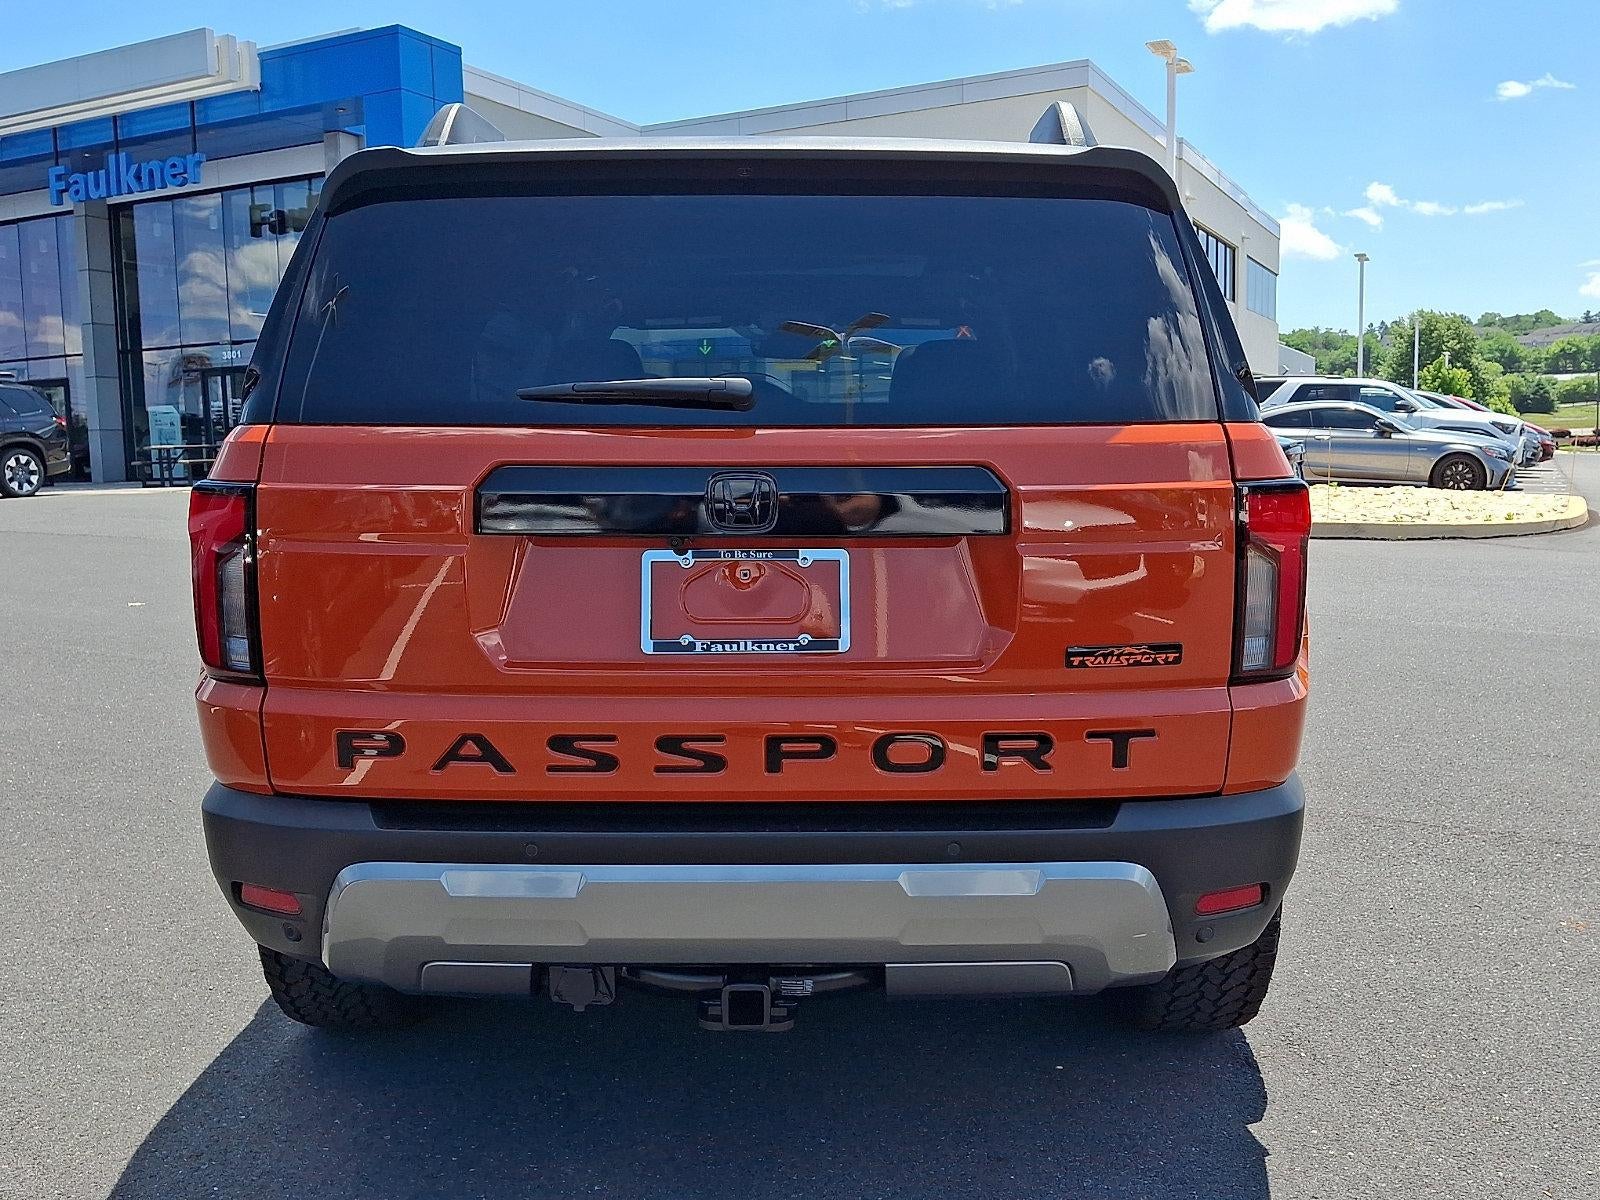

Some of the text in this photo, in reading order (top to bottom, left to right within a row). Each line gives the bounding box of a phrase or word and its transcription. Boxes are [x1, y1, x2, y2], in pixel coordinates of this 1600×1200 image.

[48, 152, 206, 206] Faulkner
[718, 550, 774, 559] To Be Sure
[693, 641, 800, 652] Faulkner
[1070, 653, 1180, 667] TRAILSPORT
[334, 727, 1158, 776] PASSPORT
